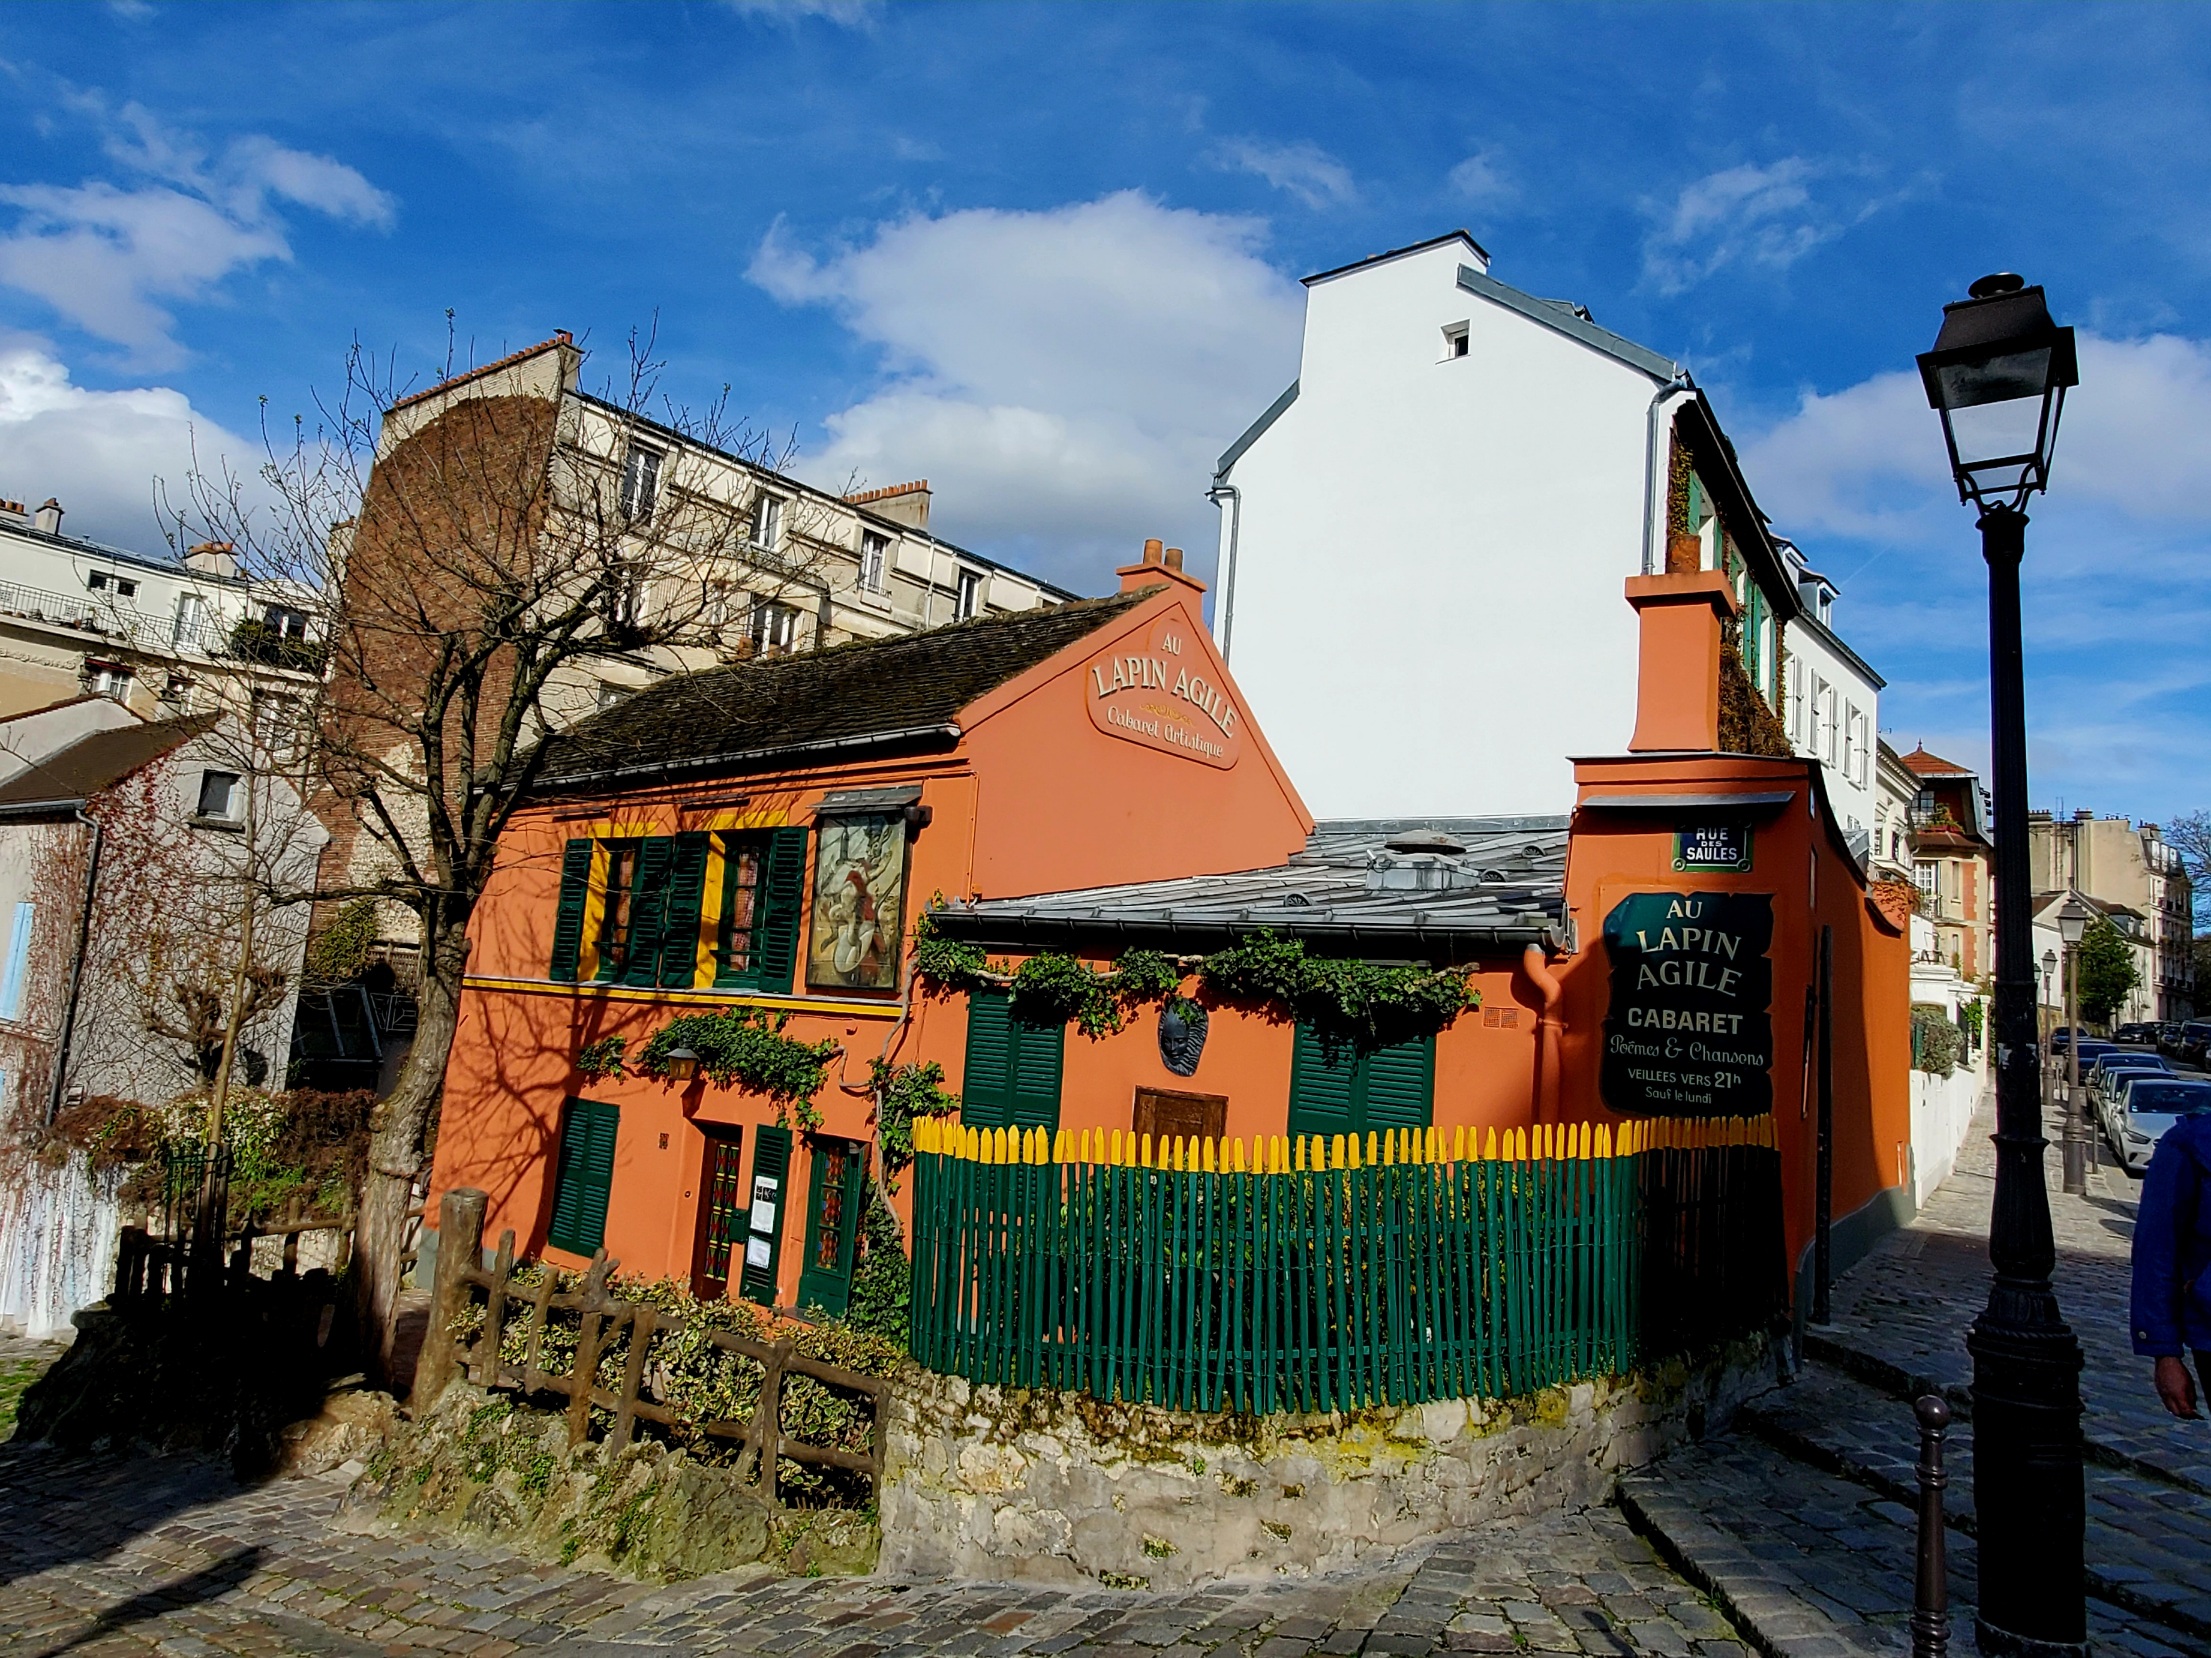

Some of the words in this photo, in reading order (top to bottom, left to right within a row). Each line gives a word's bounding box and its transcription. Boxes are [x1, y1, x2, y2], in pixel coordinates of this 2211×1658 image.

[1161, 632, 1182, 656] AU
[1092, 656, 1168, 700] LAPIN
[1170, 667, 1238, 739] AGILE
[1106, 706, 1160, 738] Cabaret
[1696, 827, 1729, 841] RUE
[1686, 847, 1738, 861] SAULES
[1665, 899, 1703, 919] AU
[1636, 926, 1742, 961] LAPIN
[1636, 960, 1743, 997] AGILE
[1627, 1007, 1743, 1035] CABARET
[1664, 1036, 1684, 1059] &
[1689, 1041, 1764, 1067] Chansons
[1627, 1067, 1677, 1084] VEILLEES
[1680, 1072, 1712, 1087] VERS
[1714, 1070, 1742, 1089] 21h
[1645, 1086, 1672, 1100] Sauf
[1674, 1088, 1683, 1101] le
[1685, 1090, 1712, 1104] lundi
